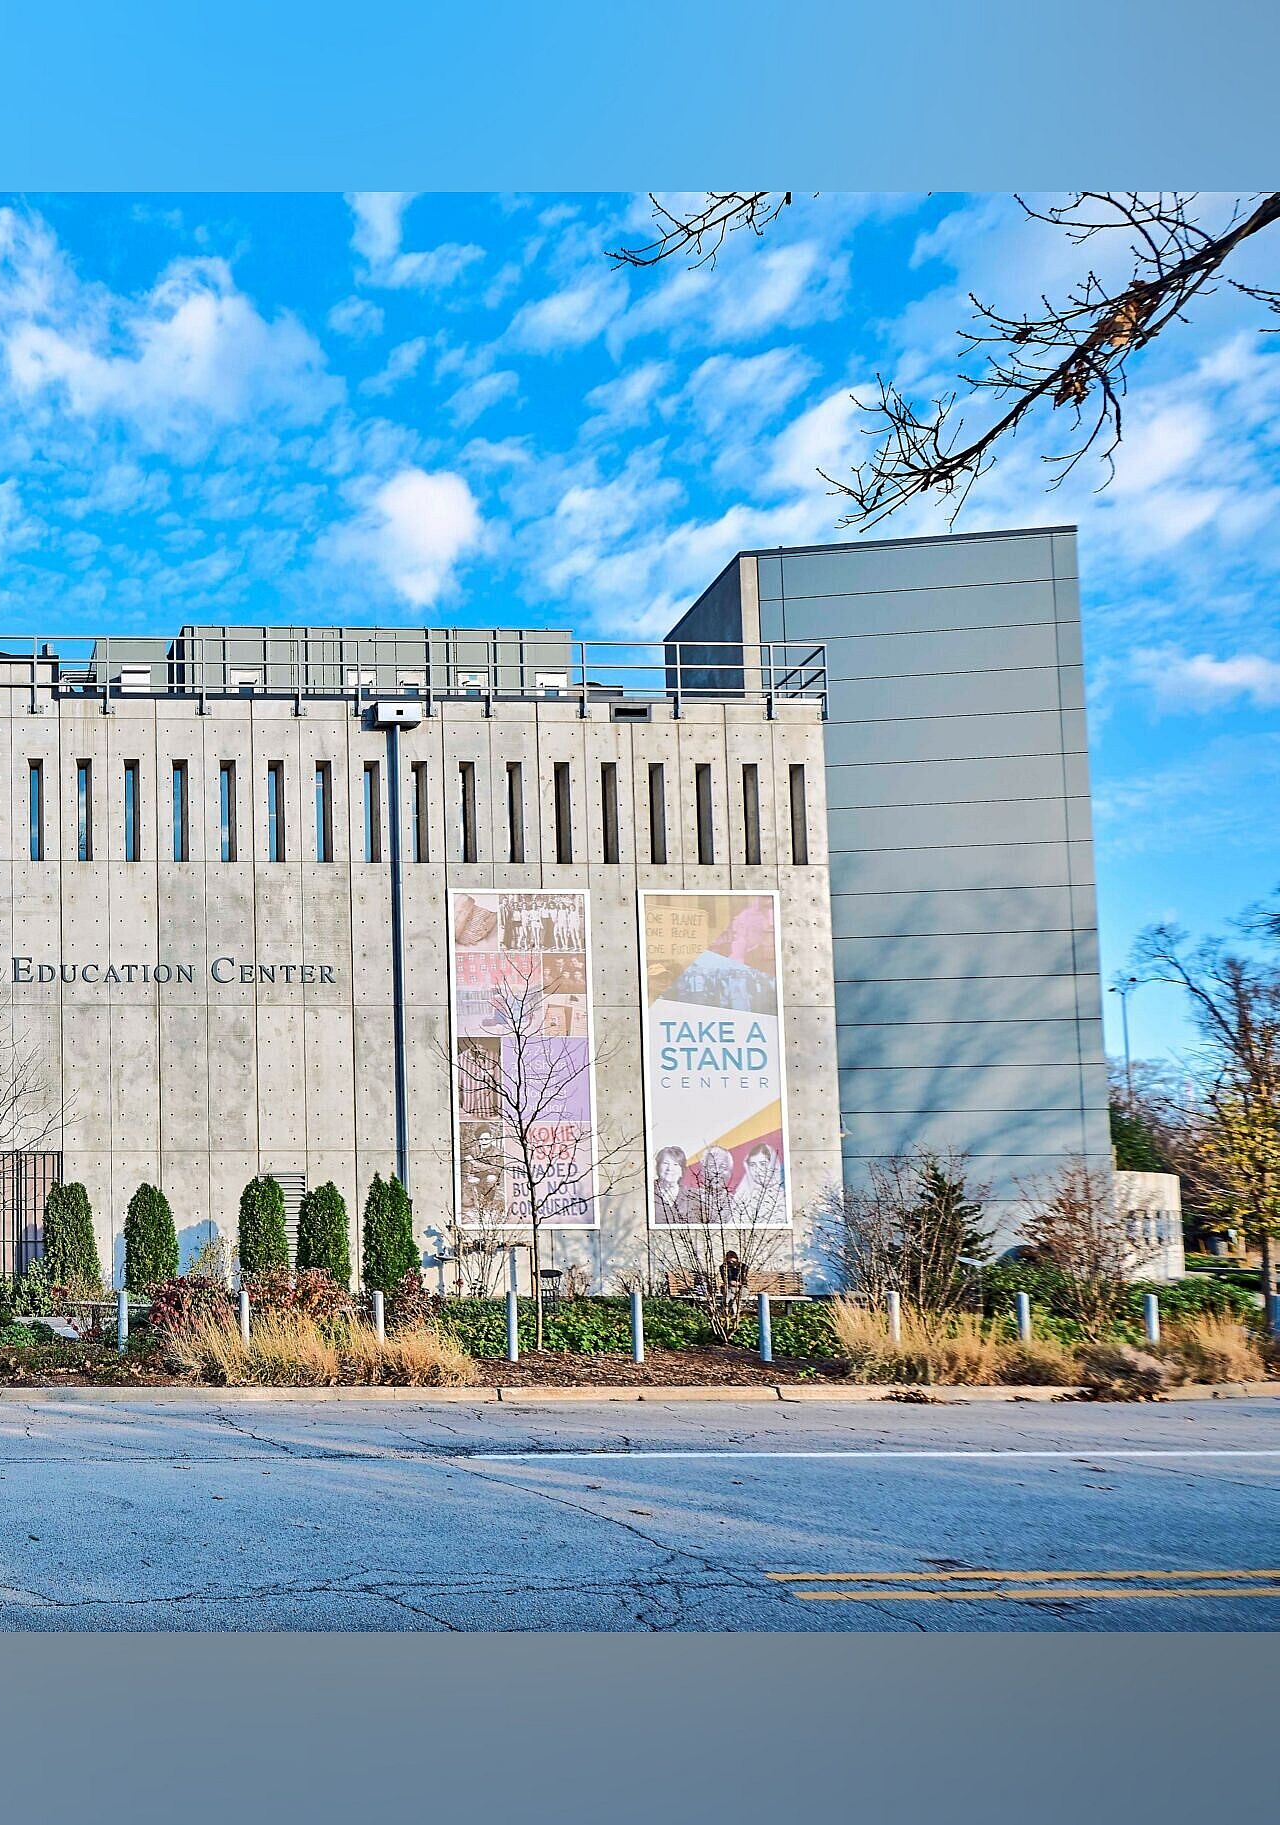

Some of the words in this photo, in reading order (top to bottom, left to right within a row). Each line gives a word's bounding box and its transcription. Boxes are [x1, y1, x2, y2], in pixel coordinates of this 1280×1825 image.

[647, 912, 664, 923] ONE
[671, 912, 704, 926] PLANET
[646, 927, 664, 938] ONE
[671, 927, 697, 939] PEOPLE
[647, 944, 665, 954] ONE
[671, 943, 703, 955] FUTURE
[11, 956, 194, 984] EDUCATION
[211, 956, 337, 984] CENTER
[659, 1021, 736, 1043] TAKE
[745, 1021, 767, 1043] A
[660, 1046, 769, 1071] STAND
[660, 1076, 770, 1089] CENTER
[524, 1126, 576, 1143] KOKIE
